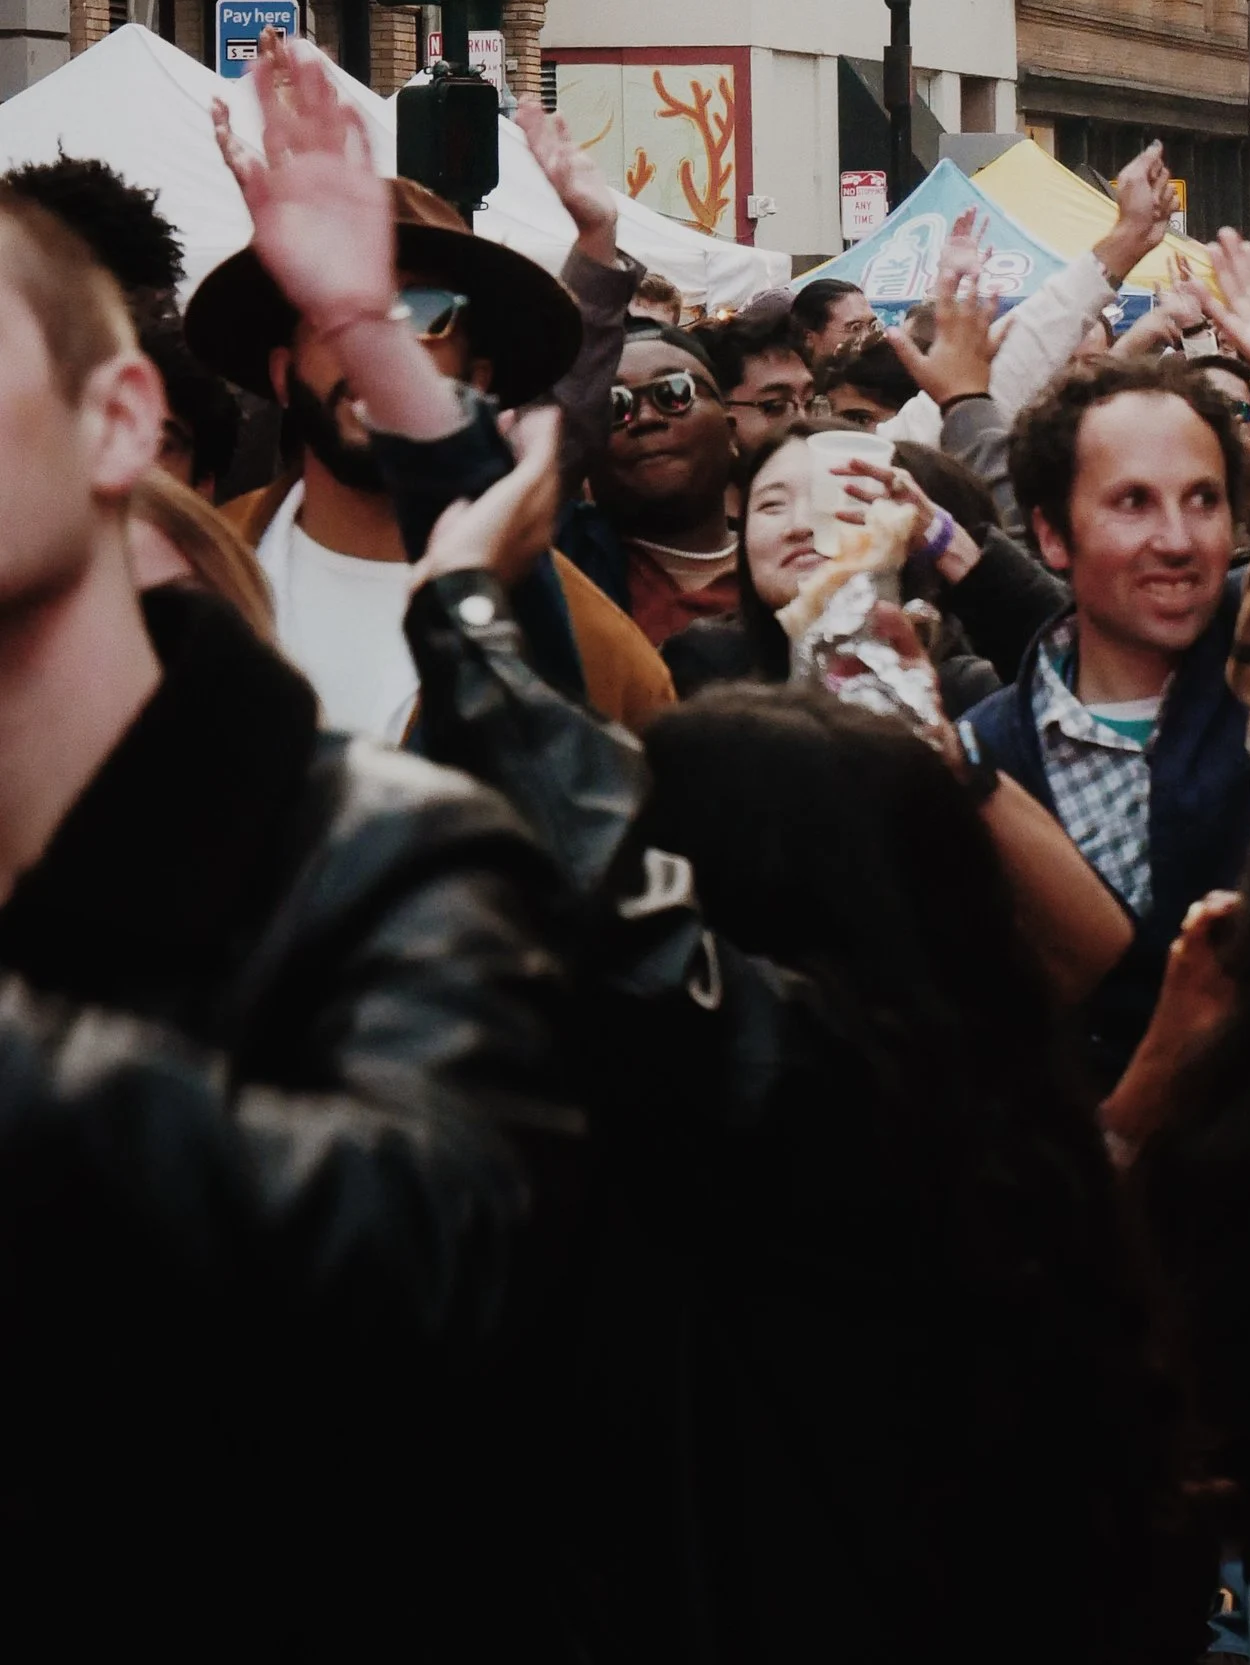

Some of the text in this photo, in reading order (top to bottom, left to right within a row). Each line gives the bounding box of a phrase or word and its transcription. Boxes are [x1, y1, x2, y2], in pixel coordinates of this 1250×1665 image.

[223, 7, 291, 27] Pay here
[468, 39, 499, 53] RKING
[843, 188, 856, 196] NO
[855, 200, 872, 210] ANY
[854, 215, 874, 224] TIME
